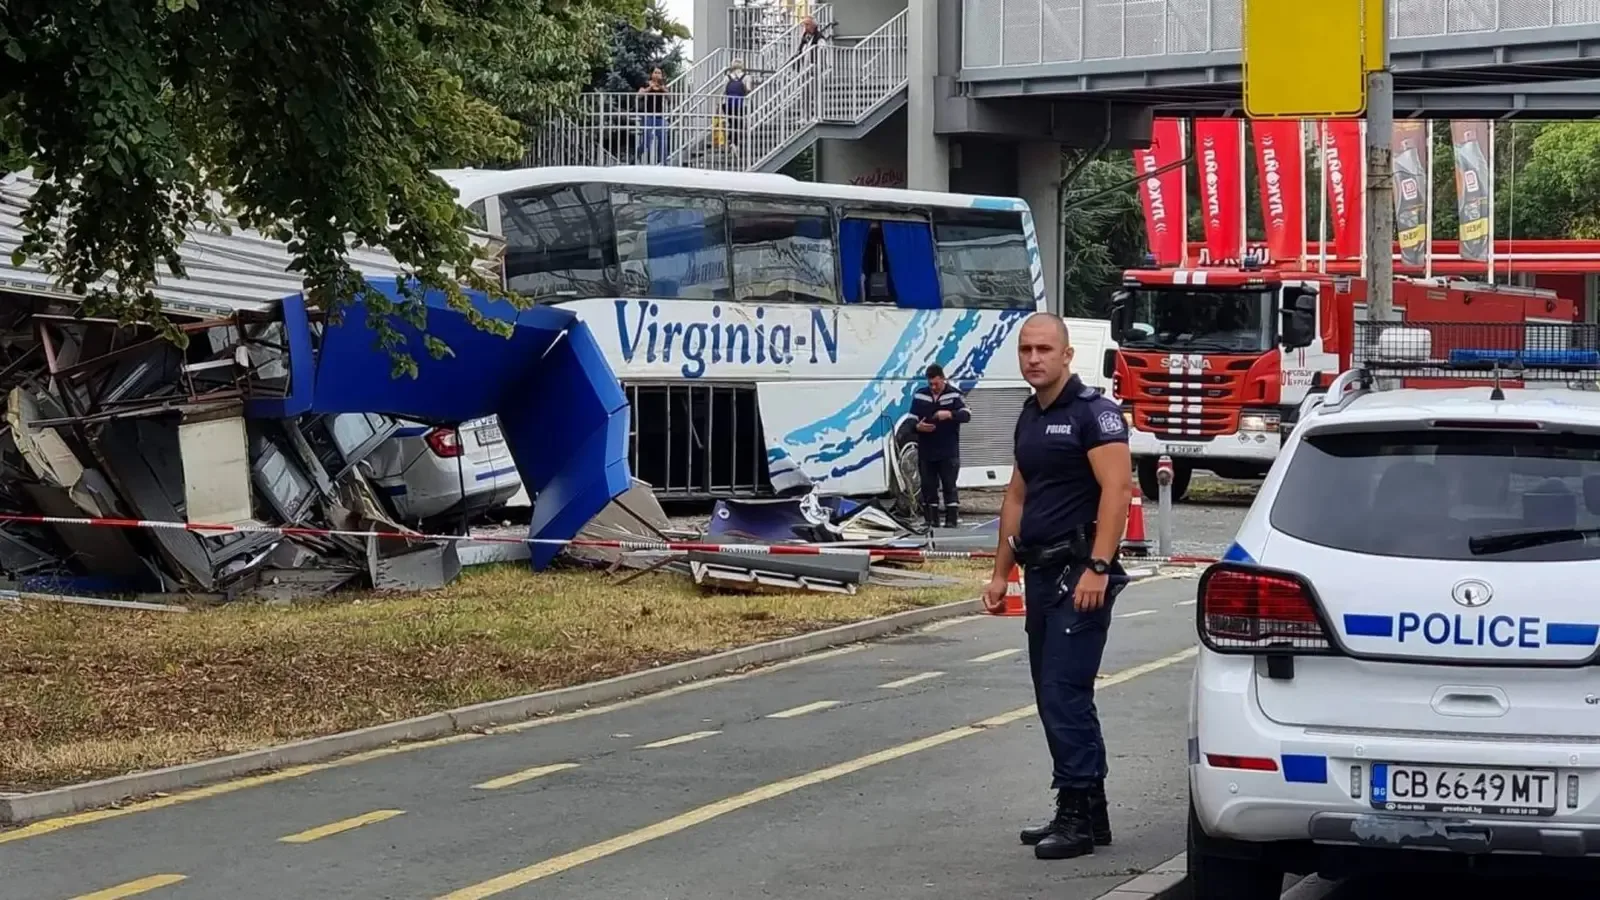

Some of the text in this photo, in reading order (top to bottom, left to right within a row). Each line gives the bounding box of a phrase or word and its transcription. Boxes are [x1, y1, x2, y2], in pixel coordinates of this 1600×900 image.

[614, 300, 839, 378] Virginia-N
[1160, 357, 1212, 370] SCANIA
[1045, 424, 1072, 435] POLICE
[1398, 612, 1541, 649] POLICE
[1392, 770, 1550, 803] CB 6649 MT
